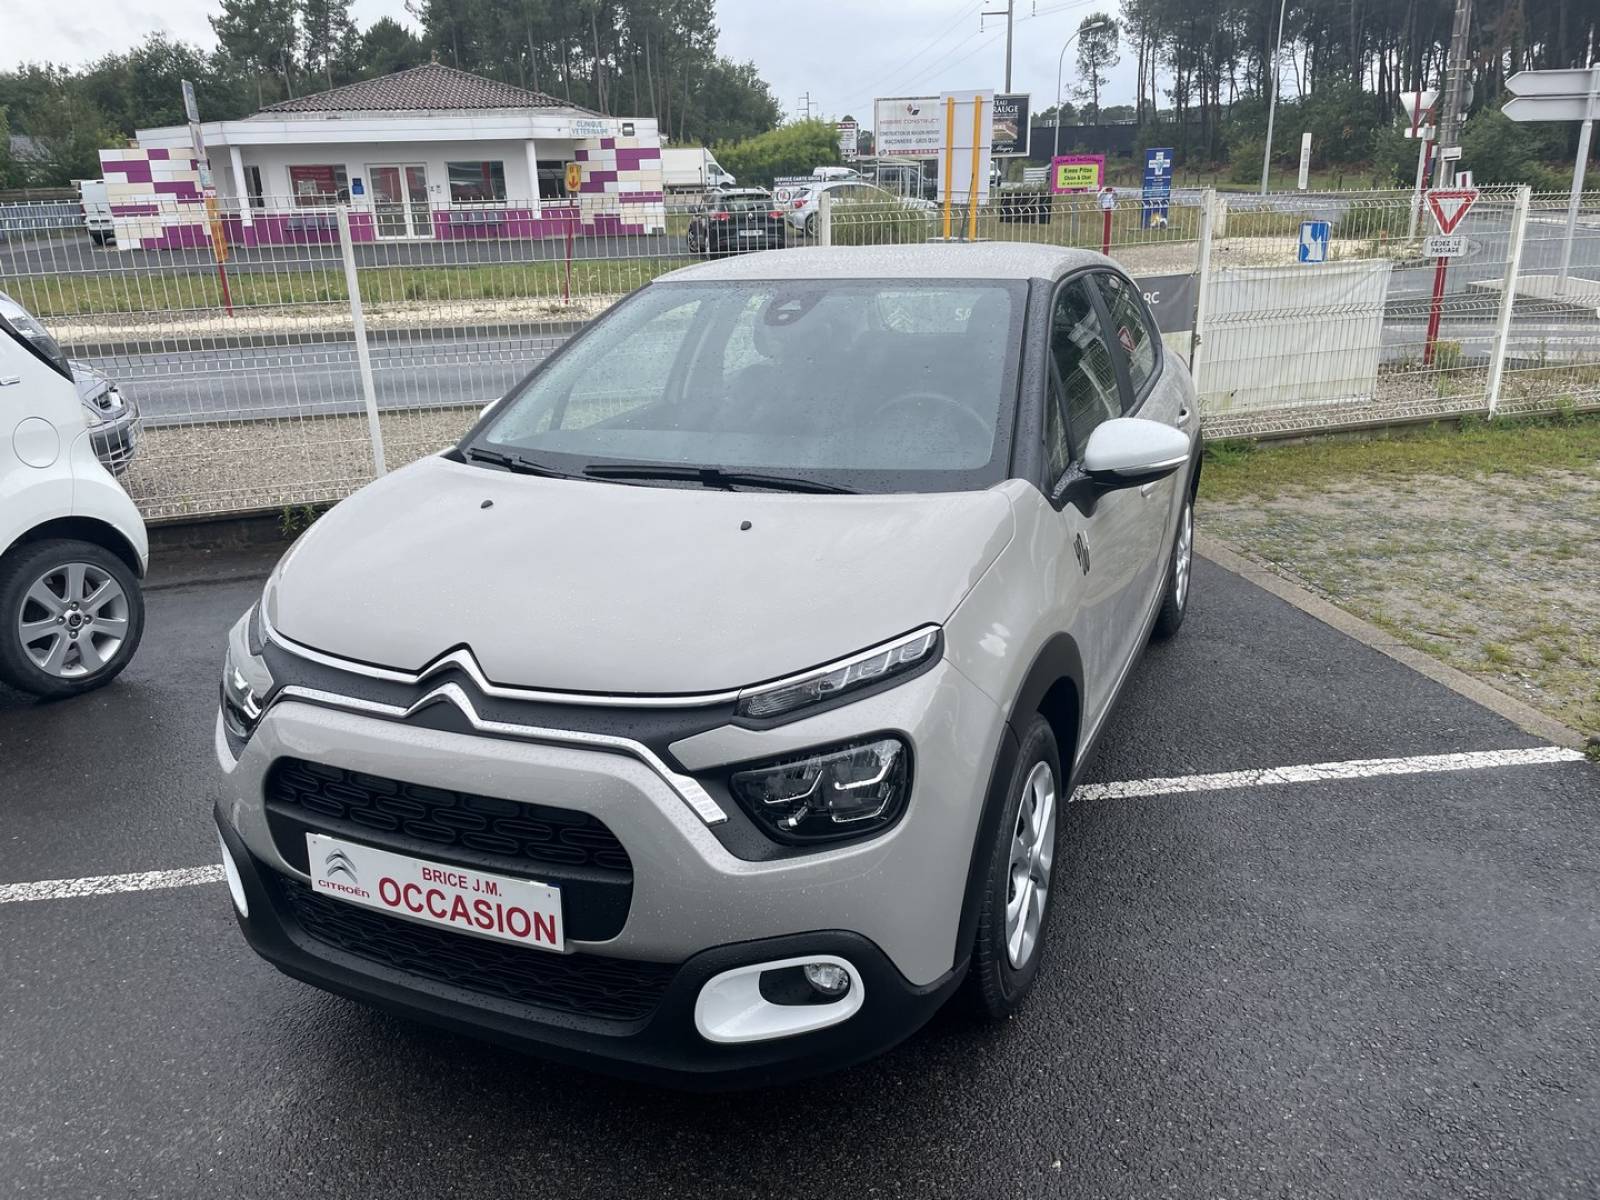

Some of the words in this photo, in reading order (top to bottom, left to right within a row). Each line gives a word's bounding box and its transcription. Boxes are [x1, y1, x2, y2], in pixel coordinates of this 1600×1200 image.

[422, 867, 468, 890] BRICE
[472, 880, 502, 897] J.M.
[378, 877, 556, 945] OCCASION
